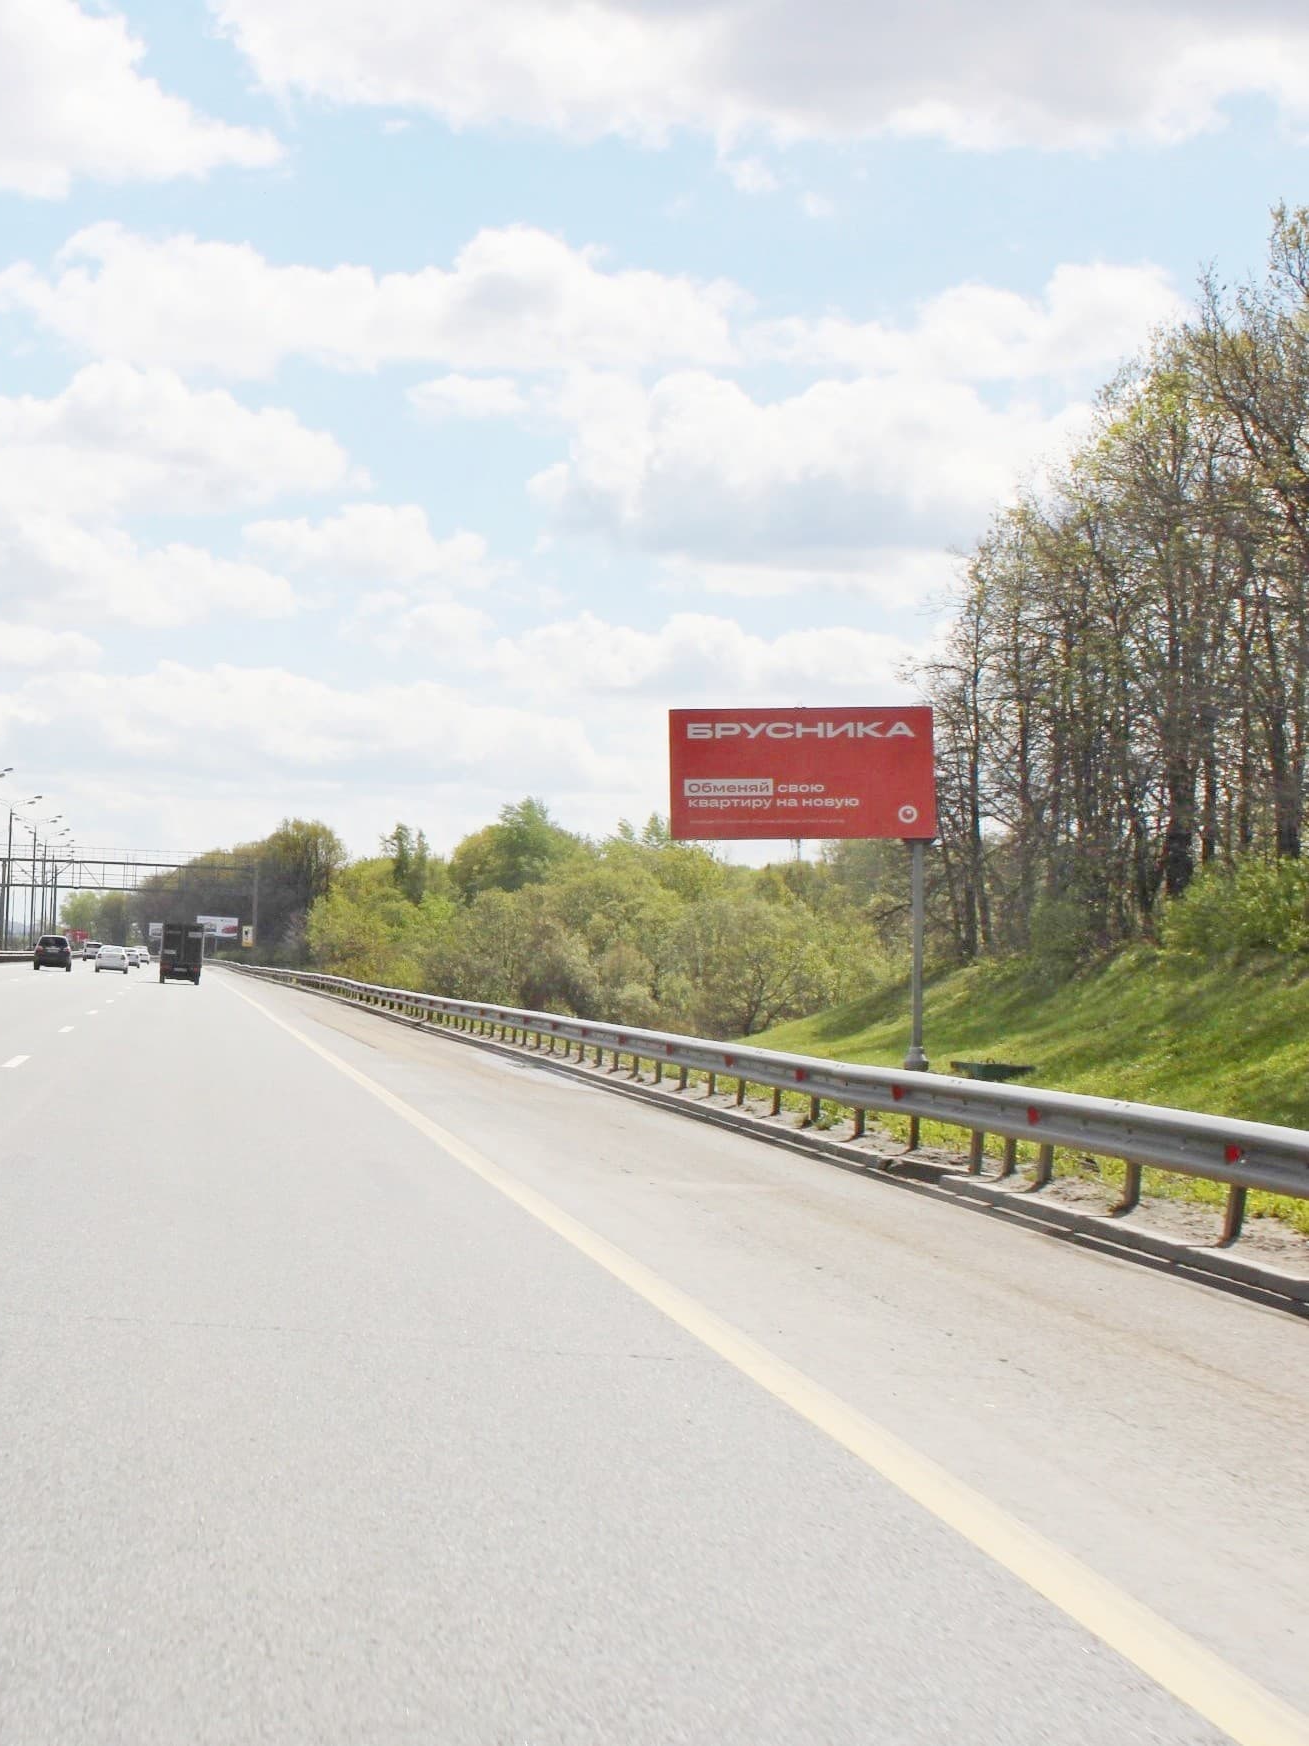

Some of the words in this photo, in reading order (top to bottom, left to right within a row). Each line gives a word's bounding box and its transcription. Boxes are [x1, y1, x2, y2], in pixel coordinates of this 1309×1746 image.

[686, 721, 916, 740] БРУСНИКА
[688, 782, 770, 794] Обменяй
[777, 783, 826, 793] свою
[688, 797, 772, 810] квартиру
[776, 797, 799, 808] на
[801, 797, 860, 809] новую
